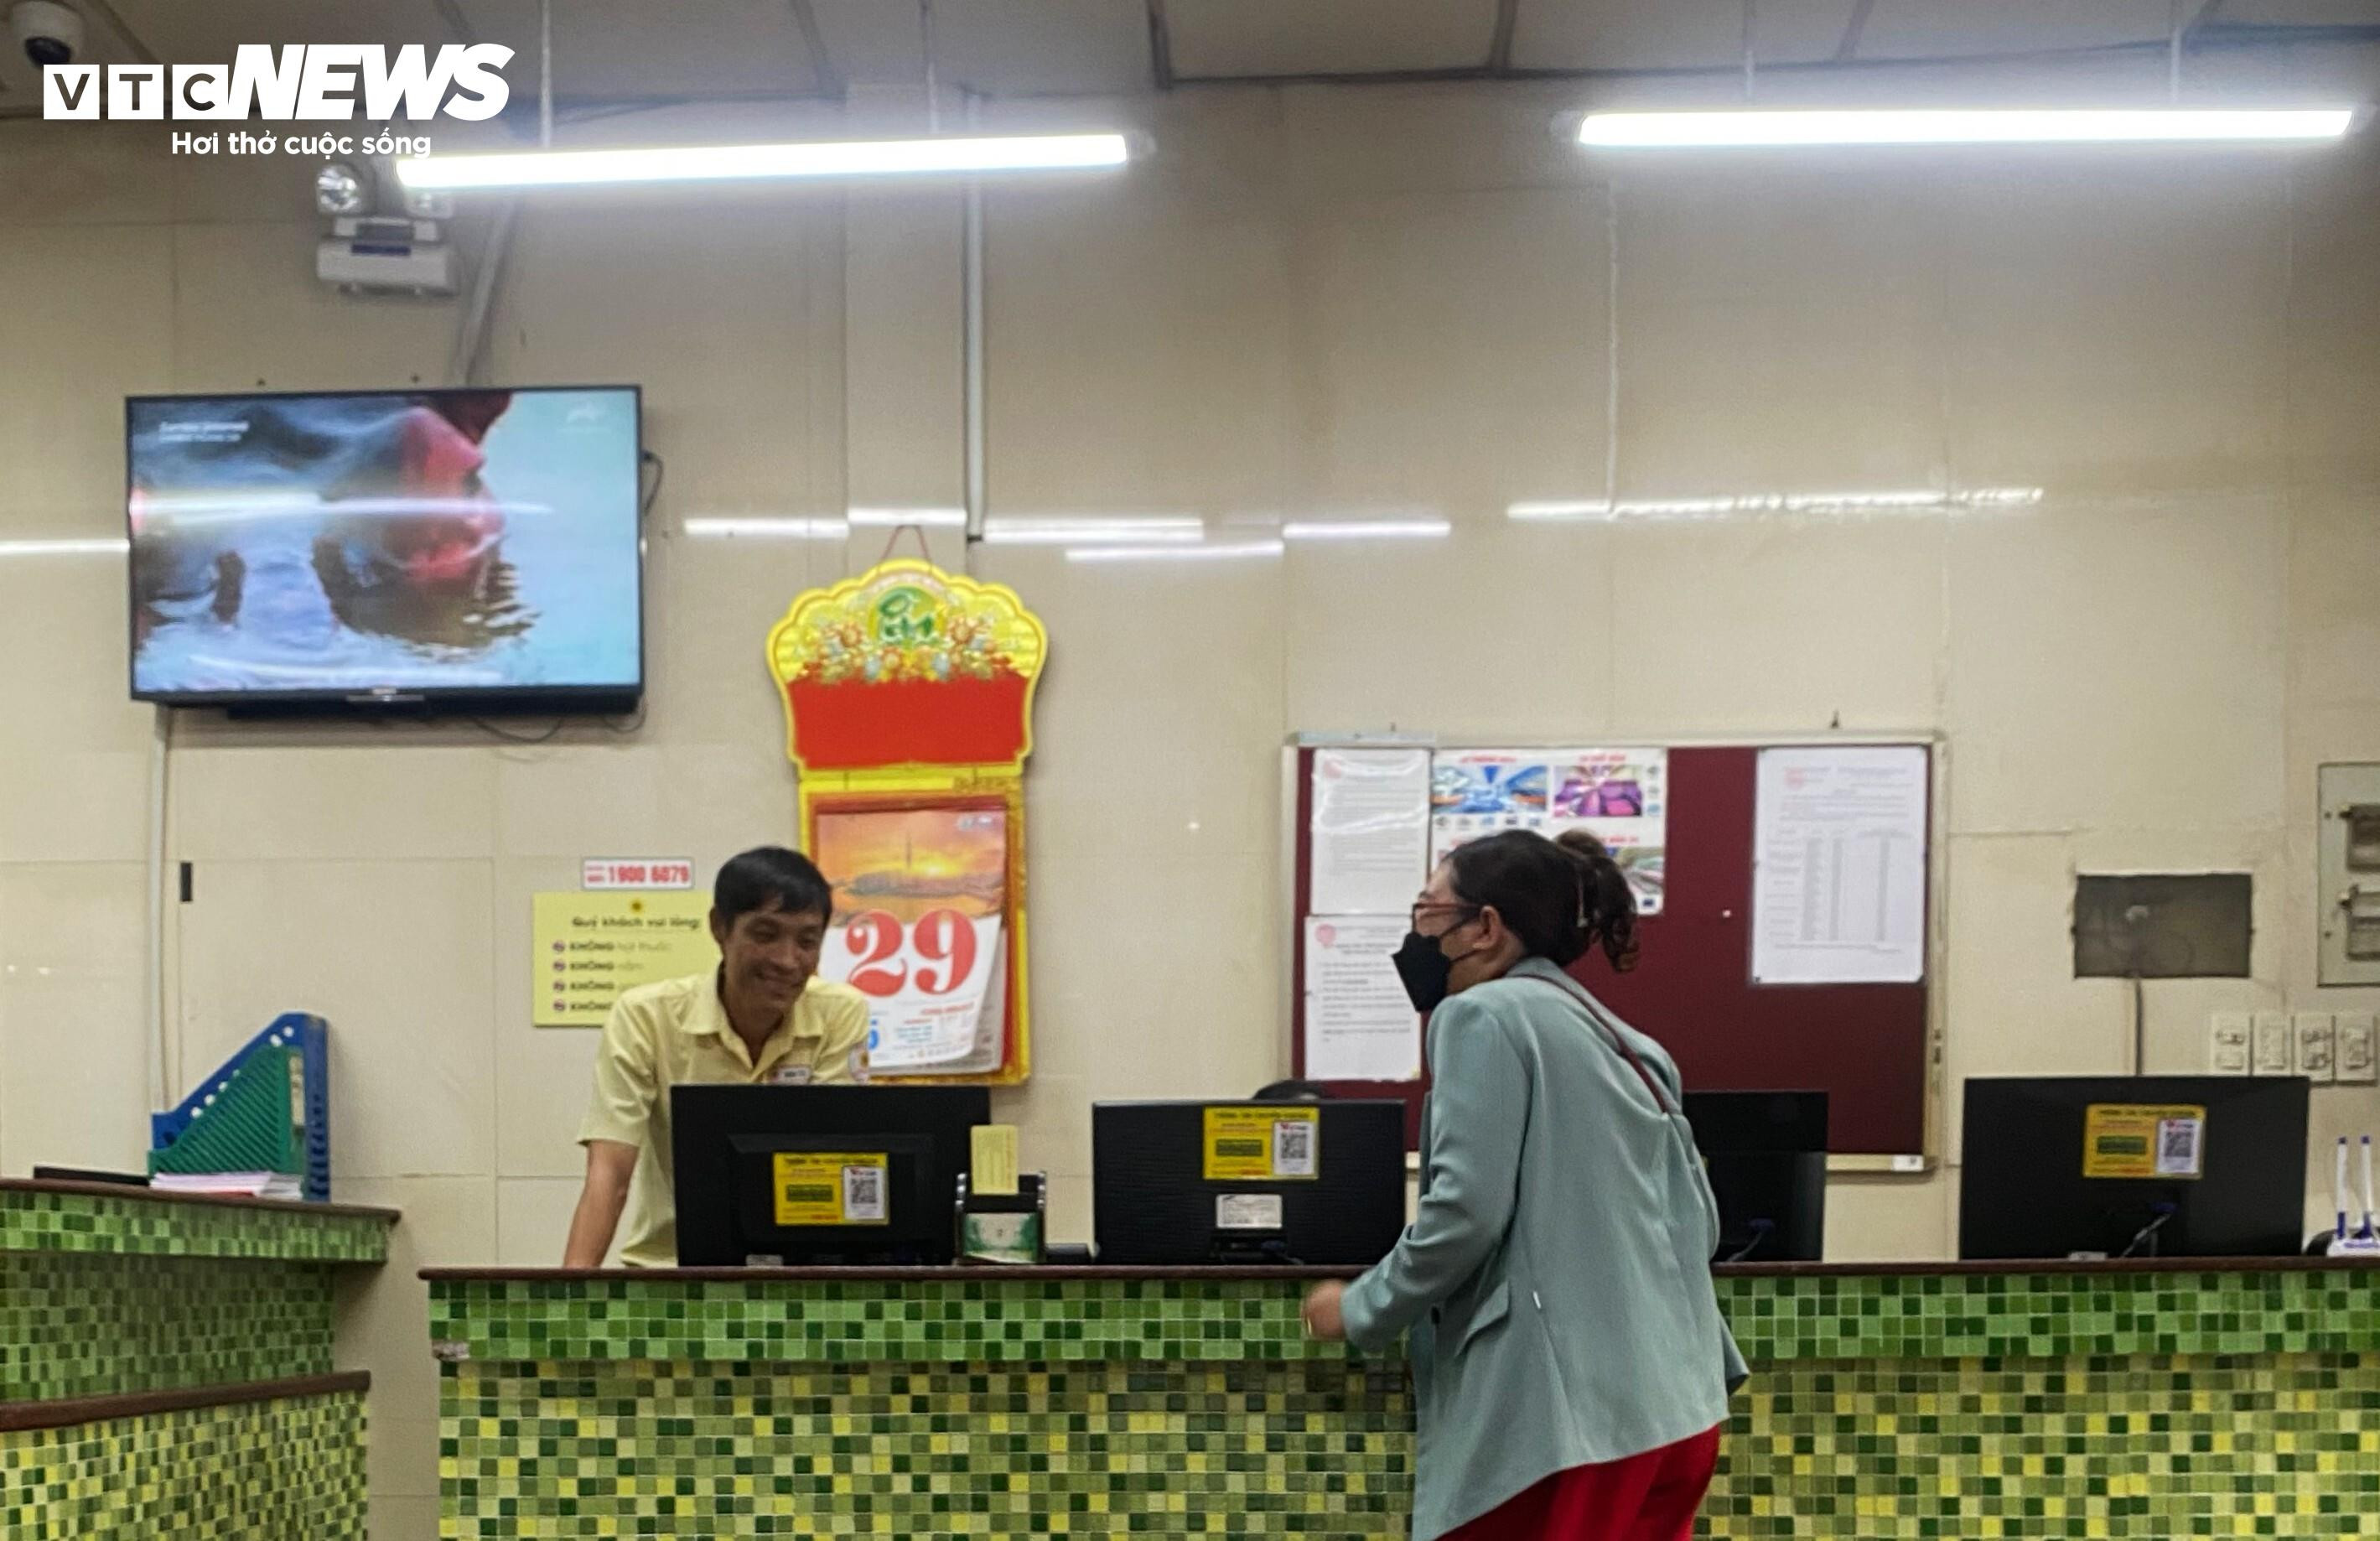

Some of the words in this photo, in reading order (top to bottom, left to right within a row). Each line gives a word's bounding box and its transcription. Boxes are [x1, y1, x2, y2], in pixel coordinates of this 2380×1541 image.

[609, 865, 646, 883] 1900
[570, 941, 614, 951] KHÔNG
[846, 909, 977, 998] 29
[570, 960, 614, 971] KHÔNG
[570, 980, 614, 990] KHÔNG
